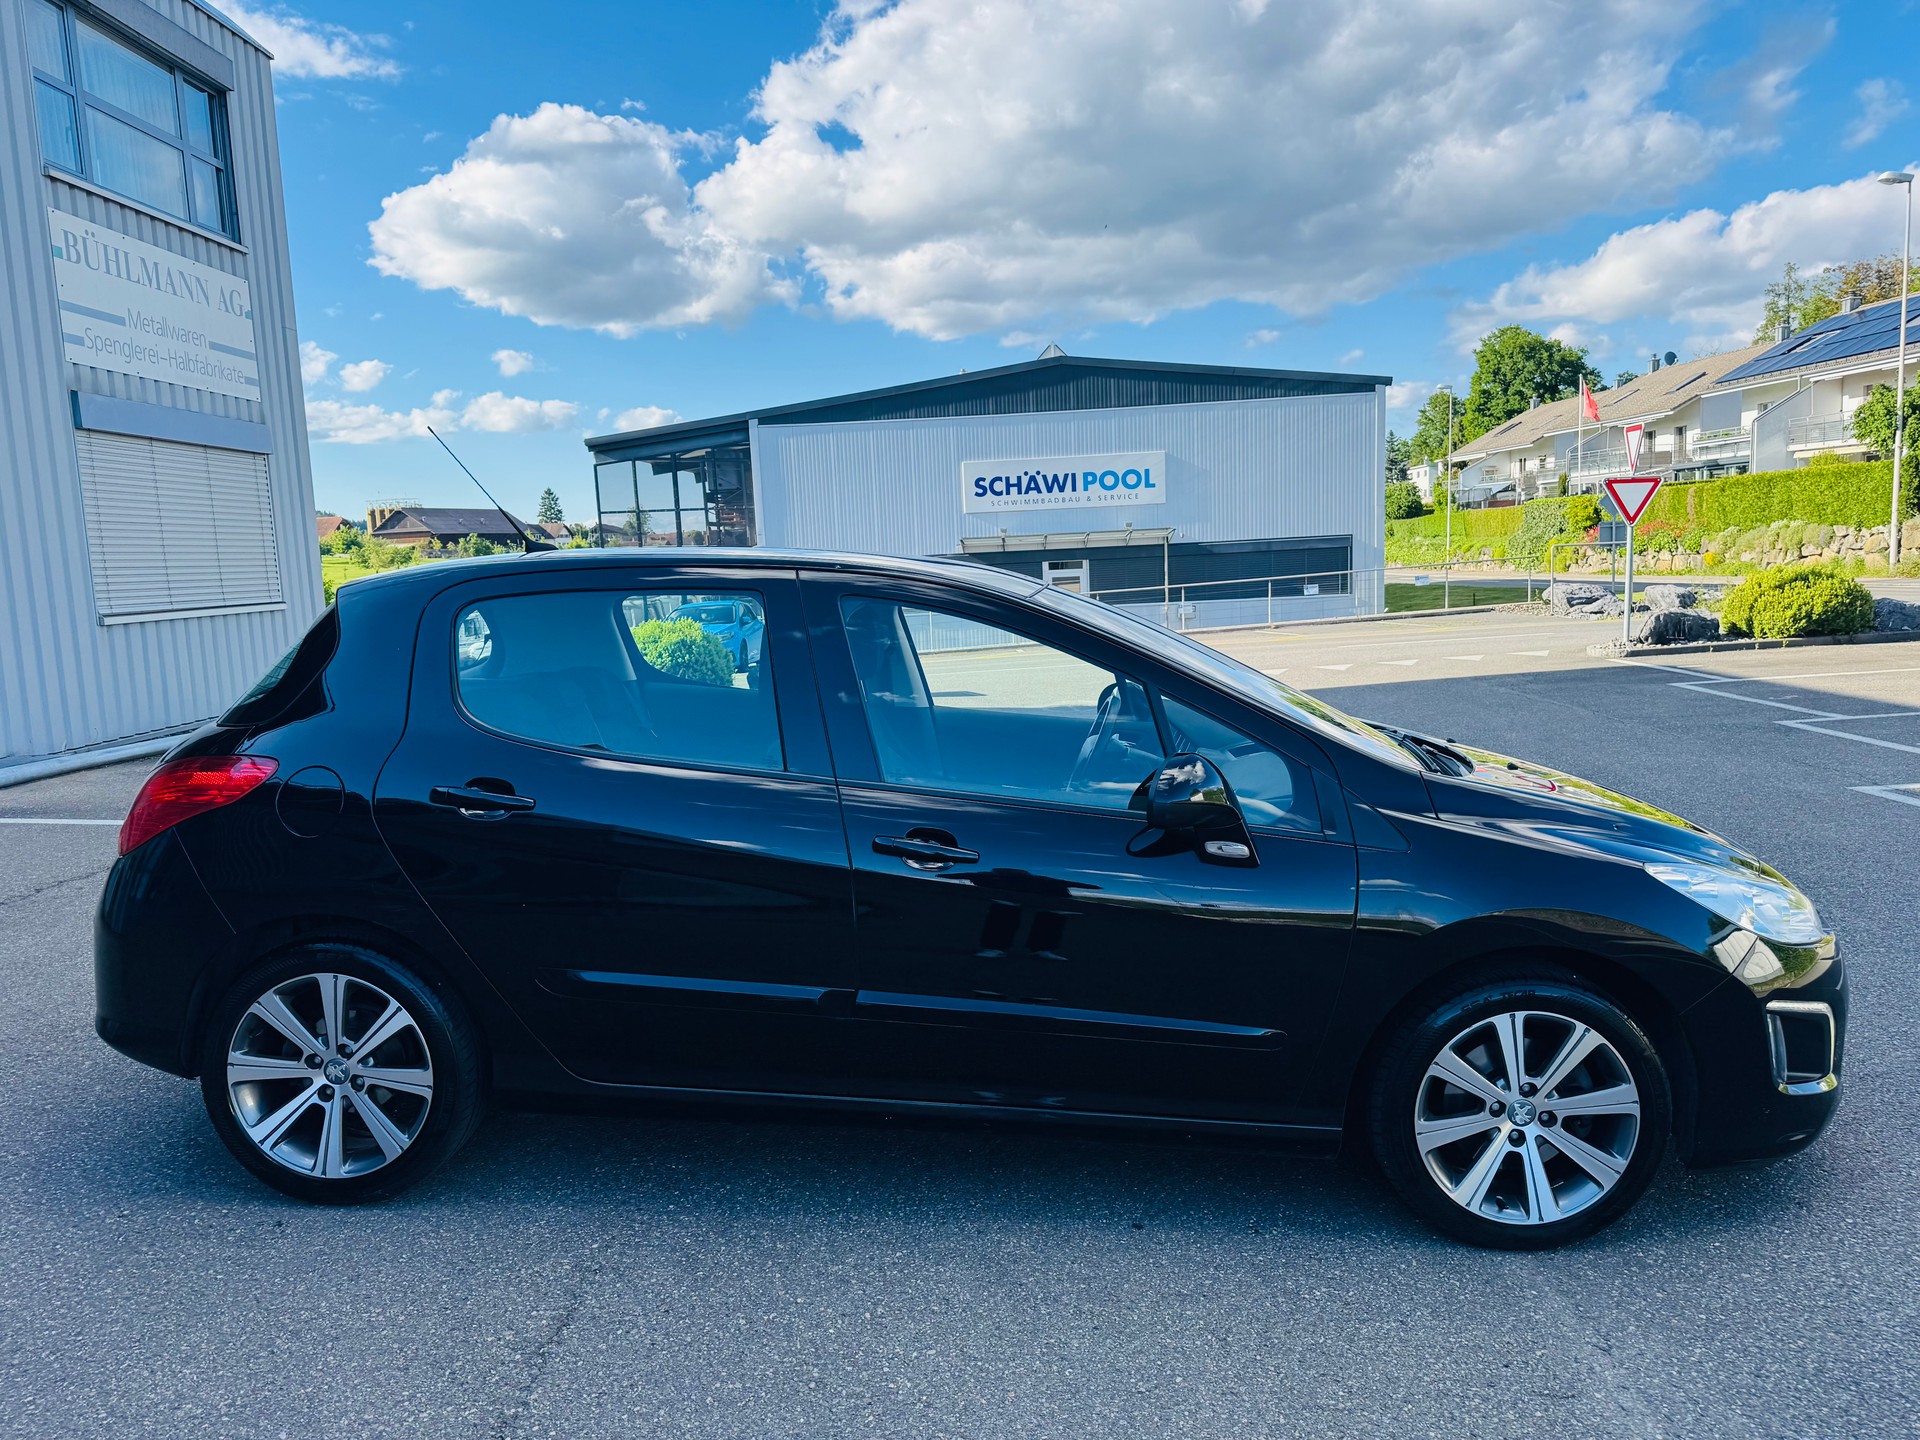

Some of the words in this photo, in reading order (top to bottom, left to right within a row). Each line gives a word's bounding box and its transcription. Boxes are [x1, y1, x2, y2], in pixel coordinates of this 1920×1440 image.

[61, 228, 210, 308] BÜHLMANN
[217, 285, 245, 317] AG
[127, 307, 207, 348] Metallwaren
[991, 496, 1081, 507] SCHWIMMBADBAU
[1098, 493, 1139, 502] SERVICE
